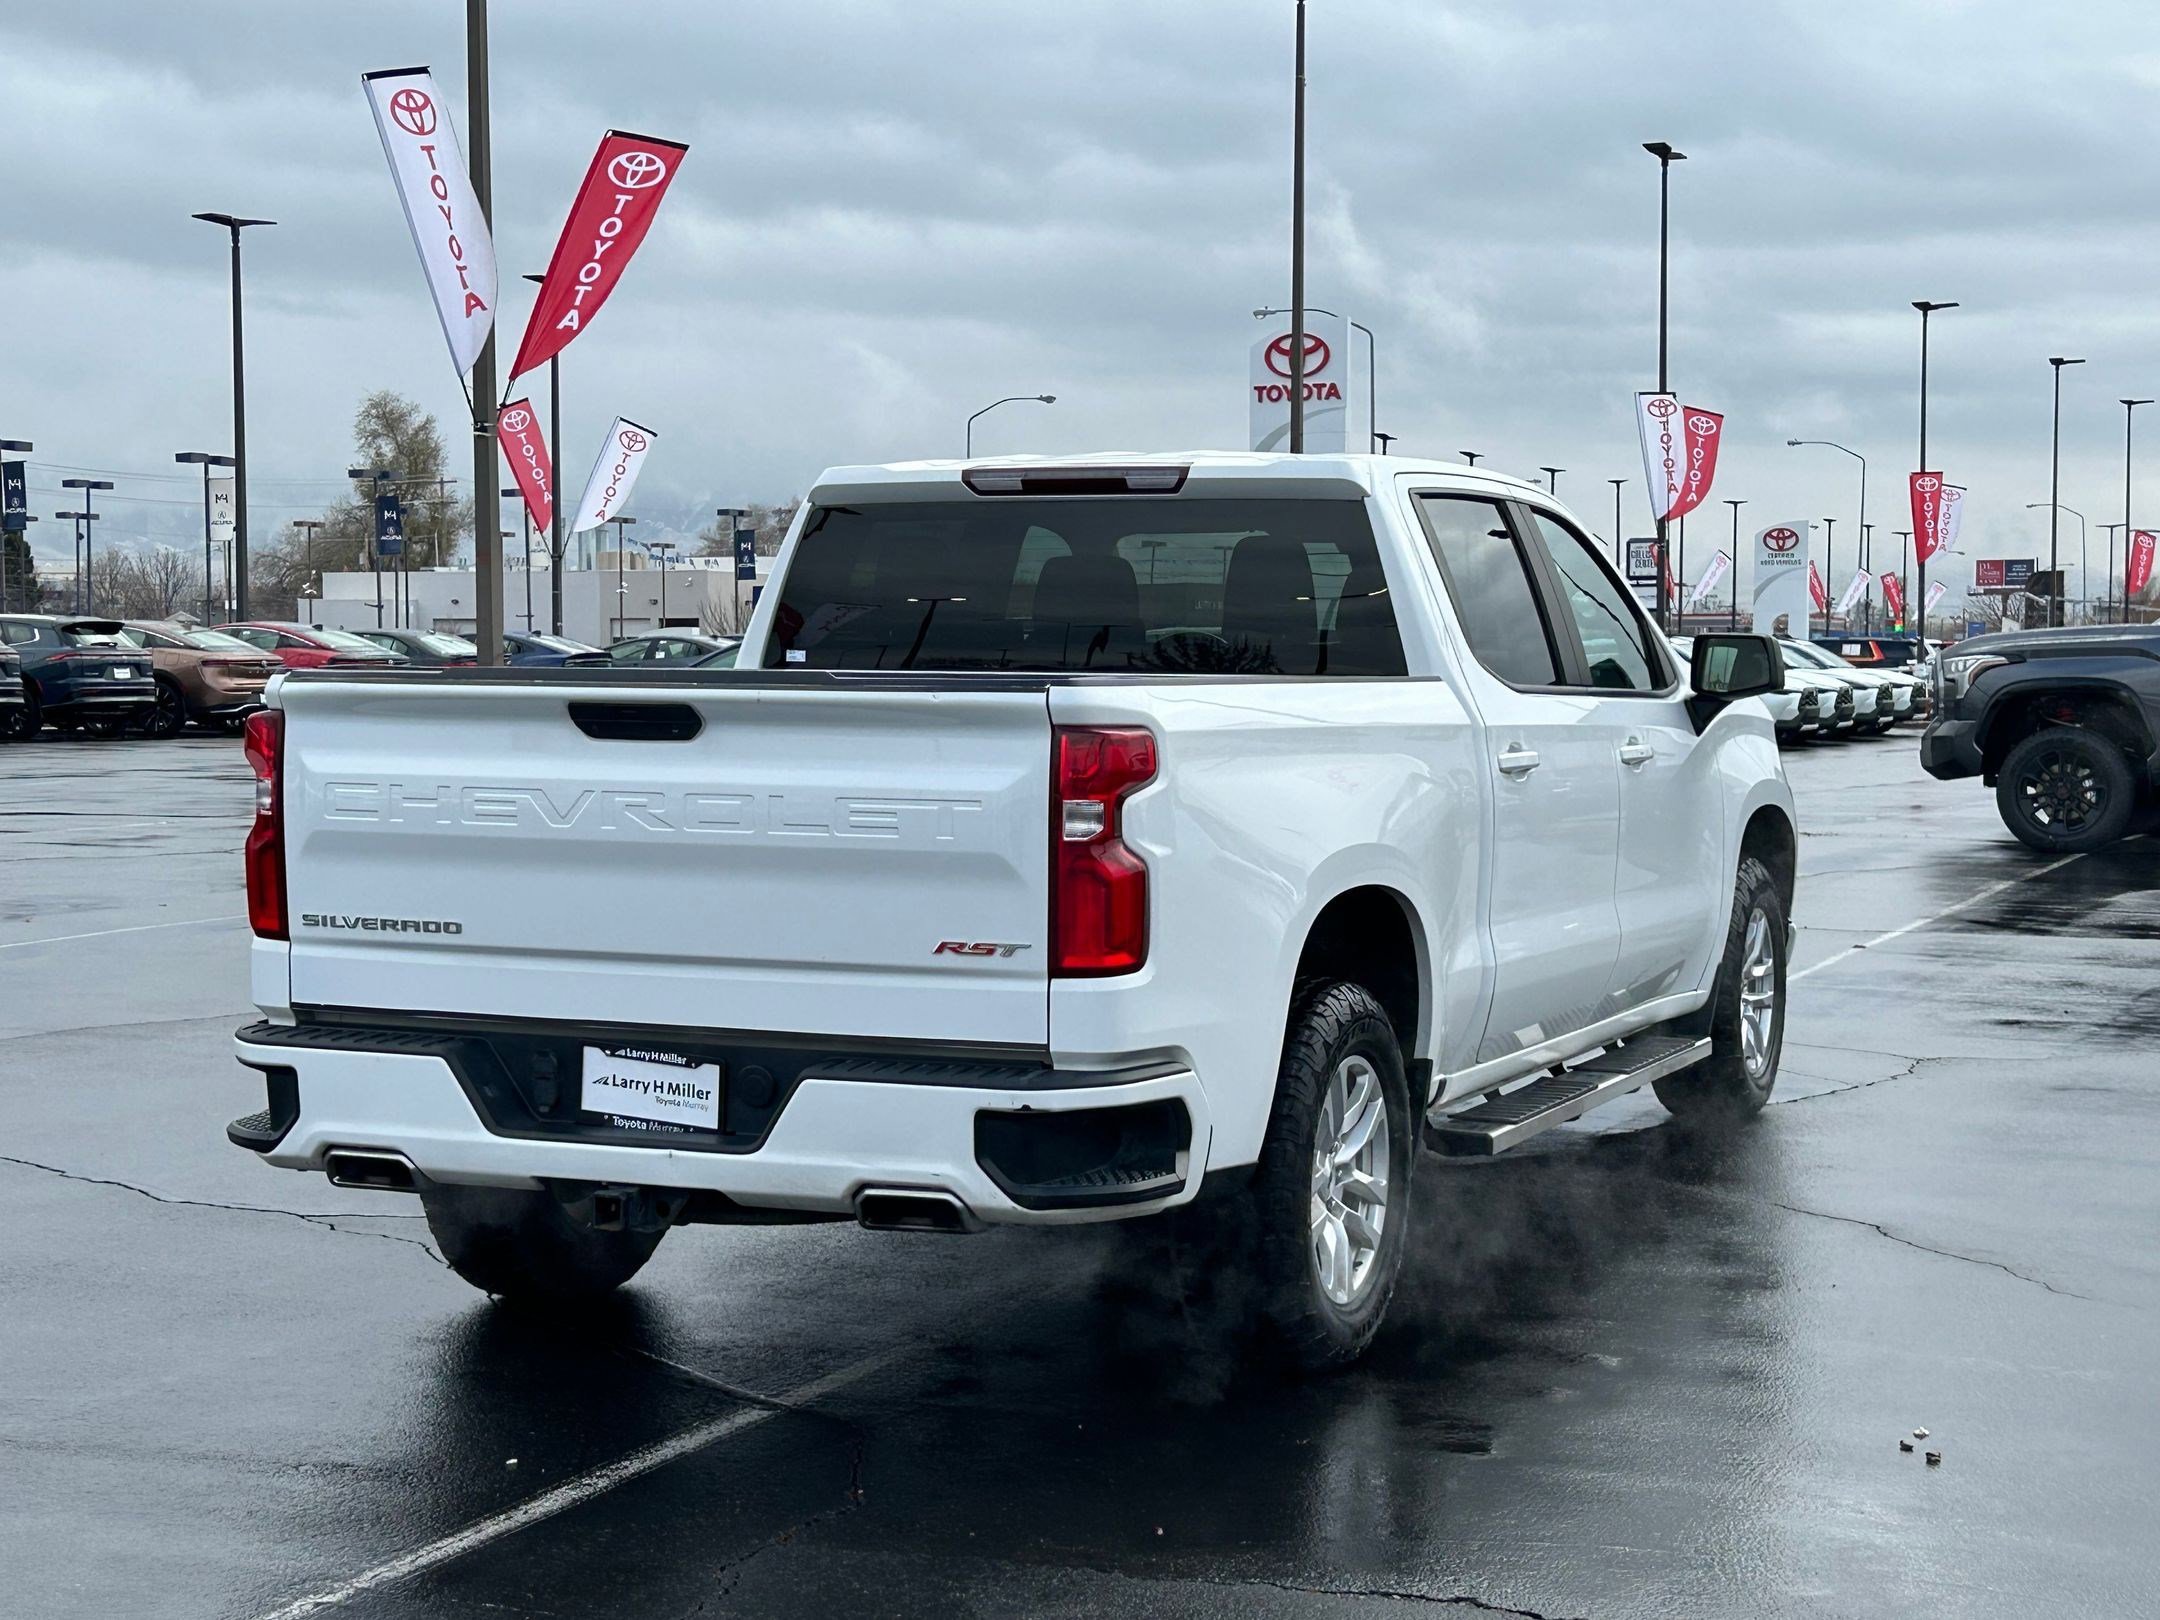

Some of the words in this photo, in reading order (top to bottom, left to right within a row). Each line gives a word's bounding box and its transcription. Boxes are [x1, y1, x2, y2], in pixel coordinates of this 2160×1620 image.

[420, 144, 488, 318] TOYOTA
[556, 194, 633, 331] TOYOTA
[1253, 382, 1342, 403] TOYOTA
[517, 432, 553, 505] TOYOTA
[1659, 420, 1679, 494] TOYOTA
[1686, 436, 1704, 502] TOYOTA
[595, 453, 631, 521] TOYOTA
[1923, 492, 1936, 547] TOYOTA
[1938, 503, 1952, 552] TOYOTA
[2136, 547, 2147, 587] TOYOTA
[324, 781, 983, 840] CHEVROLET
[302, 914, 463, 935] SILVERADO
[931, 941, 1032, 958] RST
[626, 1048, 650, 1061] Larry
[650, 1052, 659, 1061] H
[659, 1052, 688, 1065] Miller
[612, 1073, 650, 1094] Larry
[653, 1079, 664, 1093] H
[667, 1080, 712, 1100] Miller
[655, 1096, 681, 1107] Toyota
[682, 1100, 709, 1112] Murray
[612, 1115, 647, 1130] Toyota
